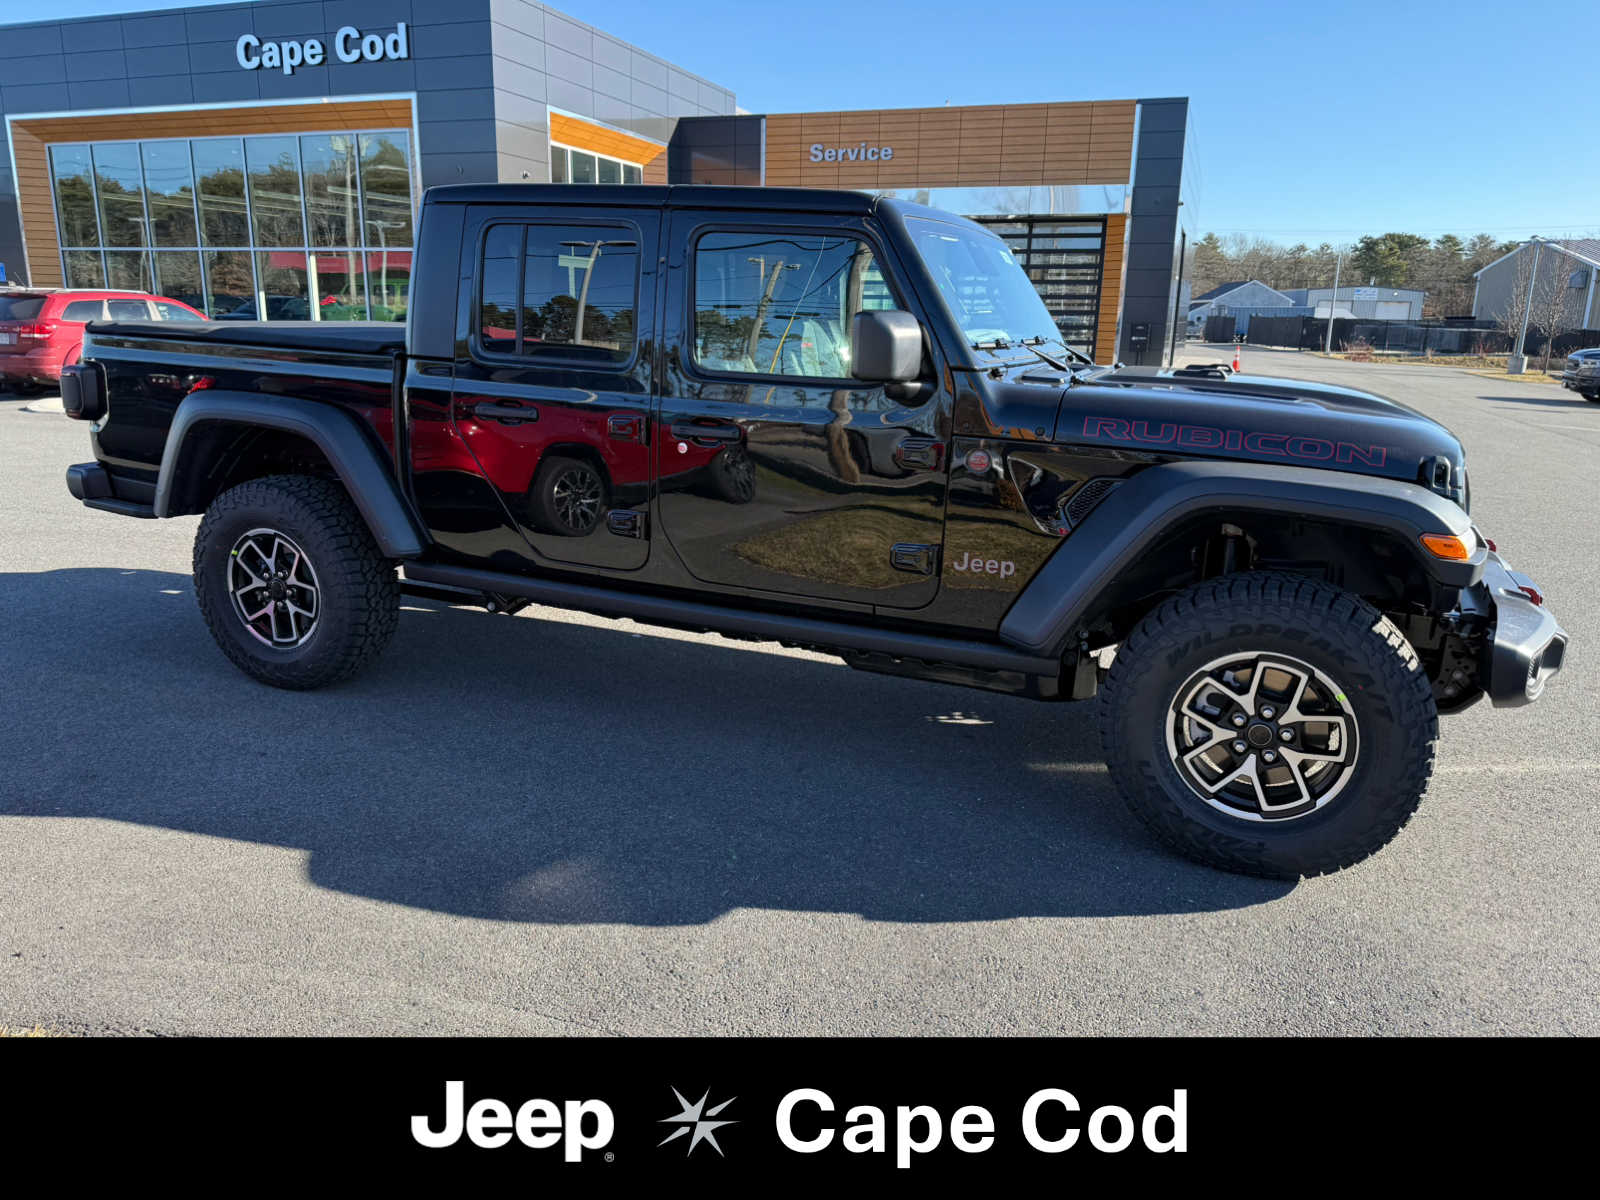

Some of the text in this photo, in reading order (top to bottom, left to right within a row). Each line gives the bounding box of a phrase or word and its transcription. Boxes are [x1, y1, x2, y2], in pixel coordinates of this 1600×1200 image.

[236, 22, 409, 76] Cape Cod
[809, 142, 894, 162] Service
[1083, 416, 1387, 467] RUBICON
[953, 551, 1016, 579] Jeep
